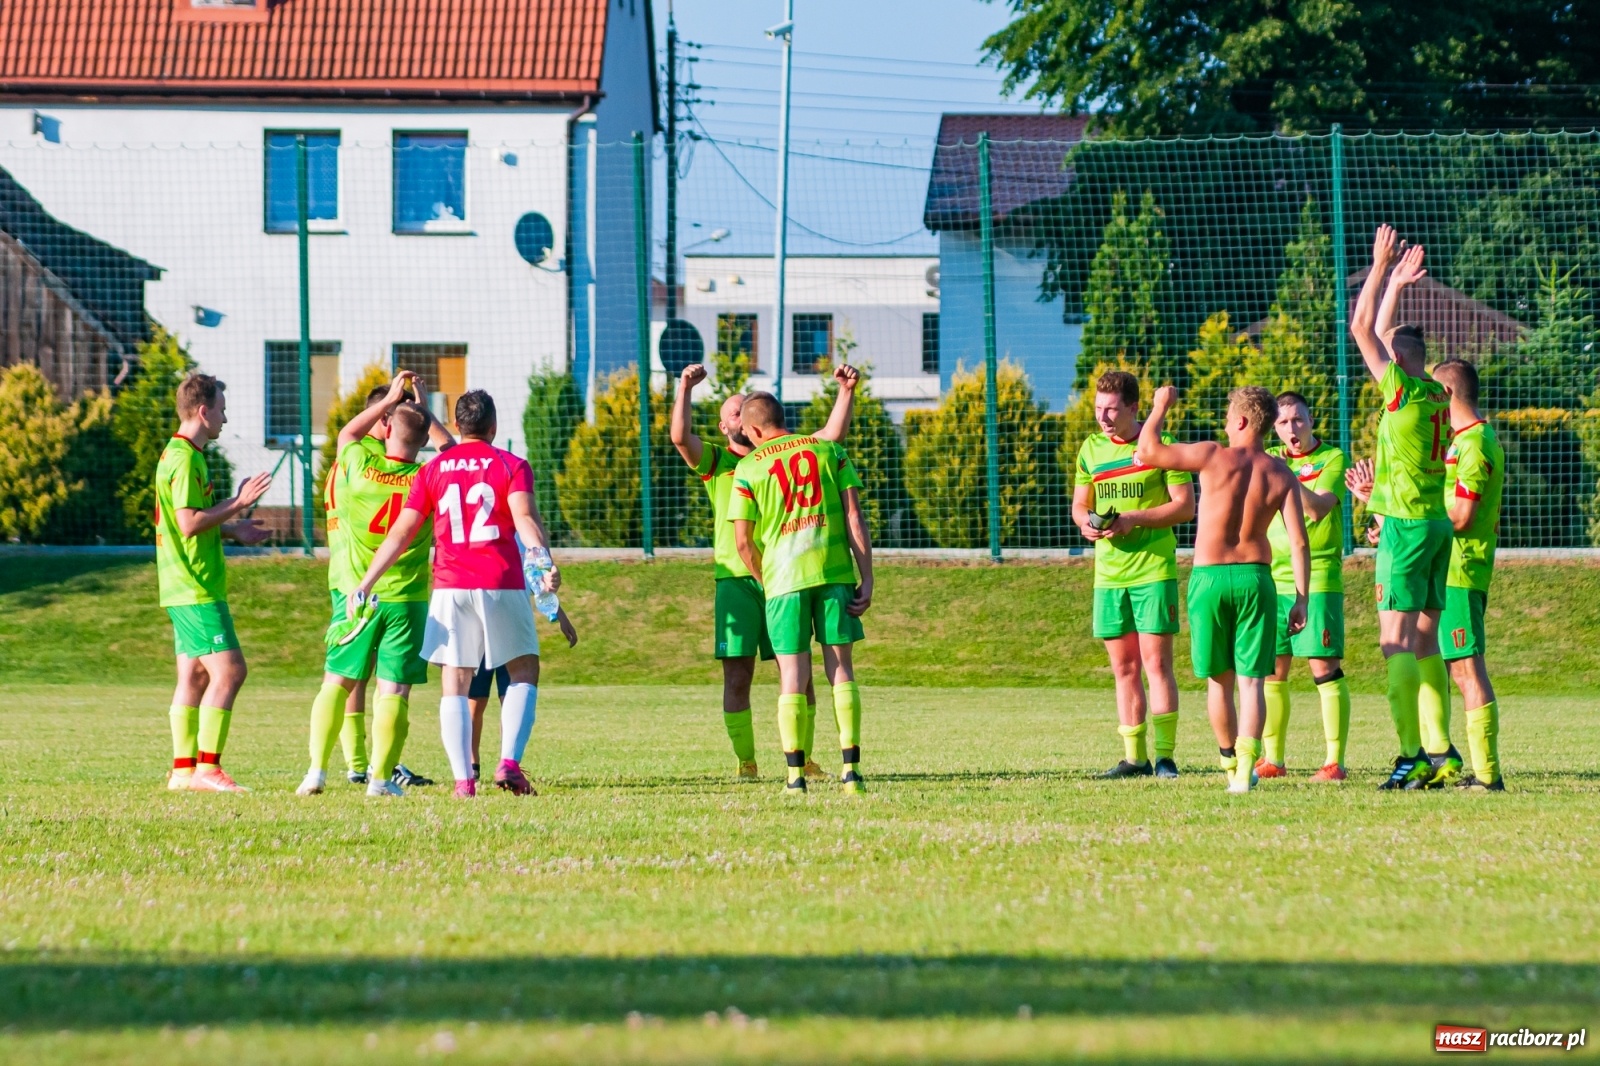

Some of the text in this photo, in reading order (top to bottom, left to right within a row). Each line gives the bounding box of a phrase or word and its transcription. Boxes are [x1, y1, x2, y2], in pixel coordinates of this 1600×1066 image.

[754, 436, 819, 462] STUDZIENNA
[440, 458, 493, 473] MAŁY
[768, 450, 822, 513] 19
[1098, 482, 1144, 499] DAR-BUD
[369, 492, 403, 535] 4
[438, 482, 500, 544] 12
[1452, 628, 1467, 648] 17
